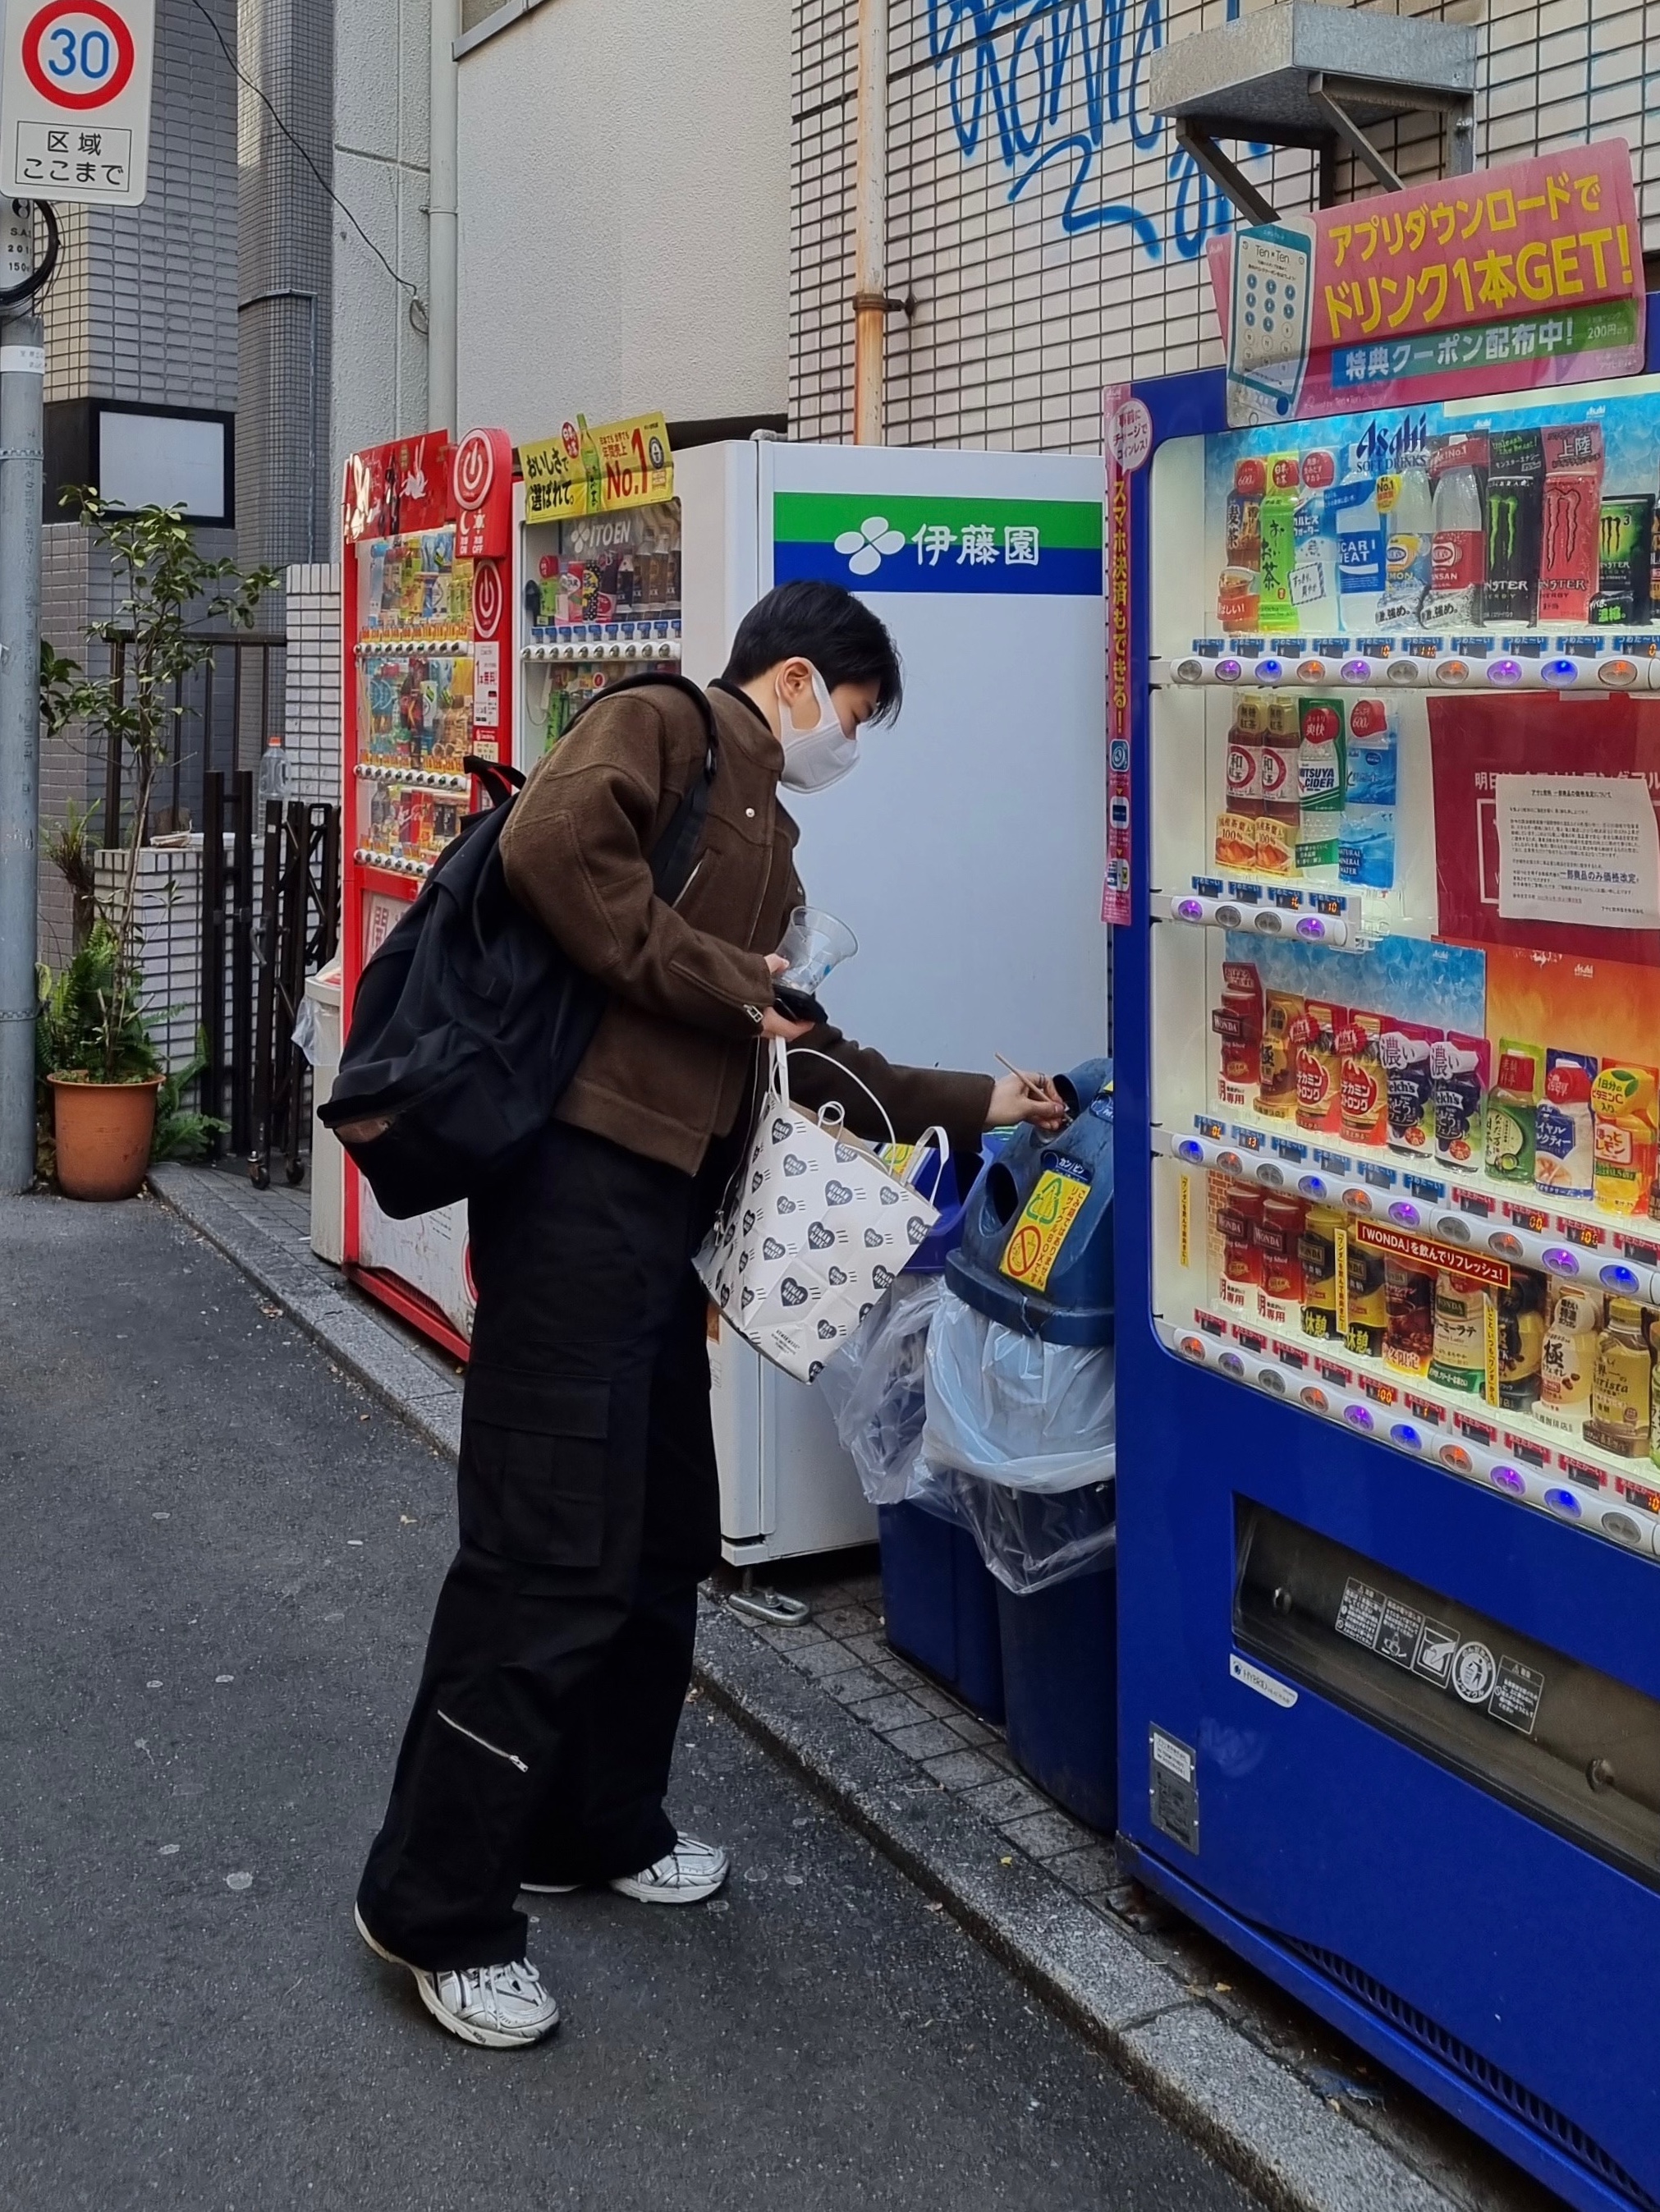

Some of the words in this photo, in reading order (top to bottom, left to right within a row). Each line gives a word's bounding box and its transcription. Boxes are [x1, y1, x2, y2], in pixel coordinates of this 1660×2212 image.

[48, 28, 109, 79] 30
[47, 131, 101, 156] 区域
[24, 158, 124, 186] ここまで
[1328, 172, 1601, 267] アプリダウンロードで
[1323, 224, 1633, 339] ドリンク1本GET!
[1346, 321, 1574, 380] 特典クーポン配布中!
[1356, 412, 1427, 459] Asahi
[1558, 436, 1592, 459] 上陸
[527, 447, 569, 480] おいしさで
[605, 428, 649, 500] No.1
[1356, 457, 1383, 473] SOFT
[1386, 454, 1427, 470] DRINKS
[530, 479, 574, 511] 選ばれて。
[1377, 482, 1395, 493] No.1
[589, 523, 612, 547] ITO
[614, 521, 631, 544] EN
[910, 523, 1039, 567] 伊藤園
[1338, 539, 1376, 552] CARI
[1306, 723, 1324, 736] 爽快
[1305, 778, 1334, 788] CIDER
[1382, 1037, 1415, 1067] 濃い
[1432, 1046, 1459, 1076] 濃い
[1593, 1090, 1623, 1104] ビタミンC
[1598, 1078, 1622, 1092] 1日分の
[1029, 1186, 1077, 1283] リサイクルBOXです
[1036, 1189, 1085, 1287] ごみ箱ではありません
[1255, 1228, 1280, 1247] WONDA
[1361, 1224, 1503, 1281] 「WONDA」を飲んでリフレッシュ!
[1544, 1340, 1564, 1369] 極
